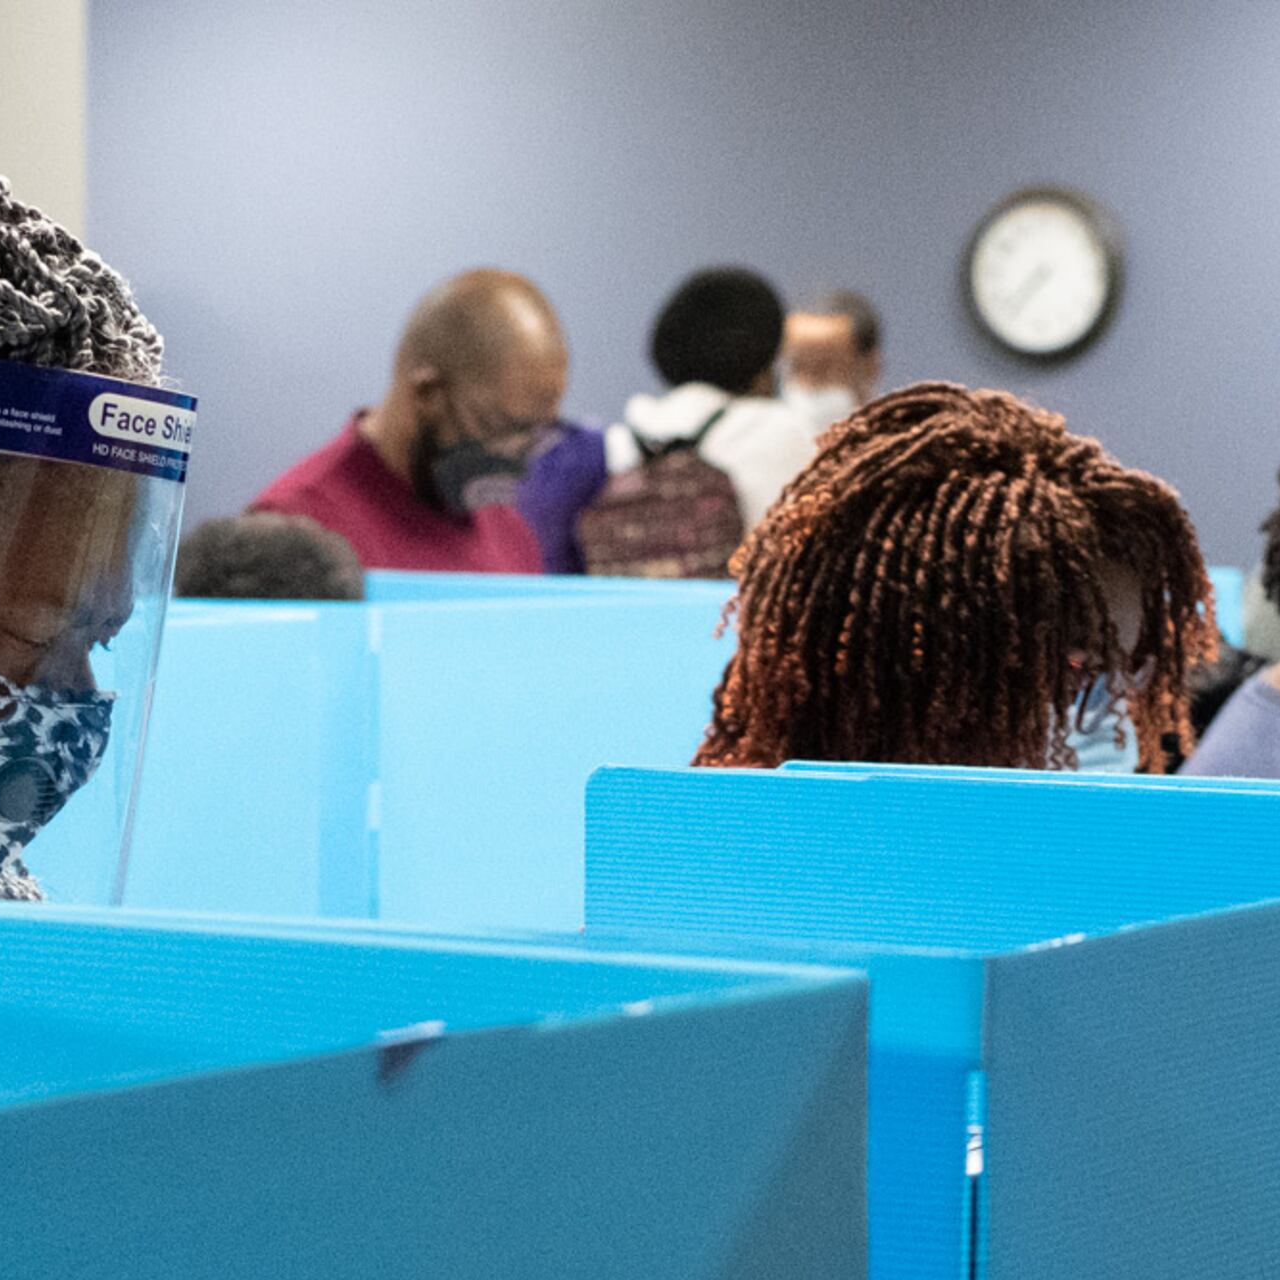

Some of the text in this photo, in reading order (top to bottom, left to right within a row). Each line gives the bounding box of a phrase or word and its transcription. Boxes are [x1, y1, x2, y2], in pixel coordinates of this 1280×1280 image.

[10, 407, 29, 419] face
[30, 411, 56, 423] shield
[100, 401, 157, 437] Face
[33, 424, 42, 432] or
[43, 425, 63, 436] dust
[92, 443, 109, 457] HD
[111, 446, 137, 462] FACE
[138, 451, 166, 468] SHIELD
